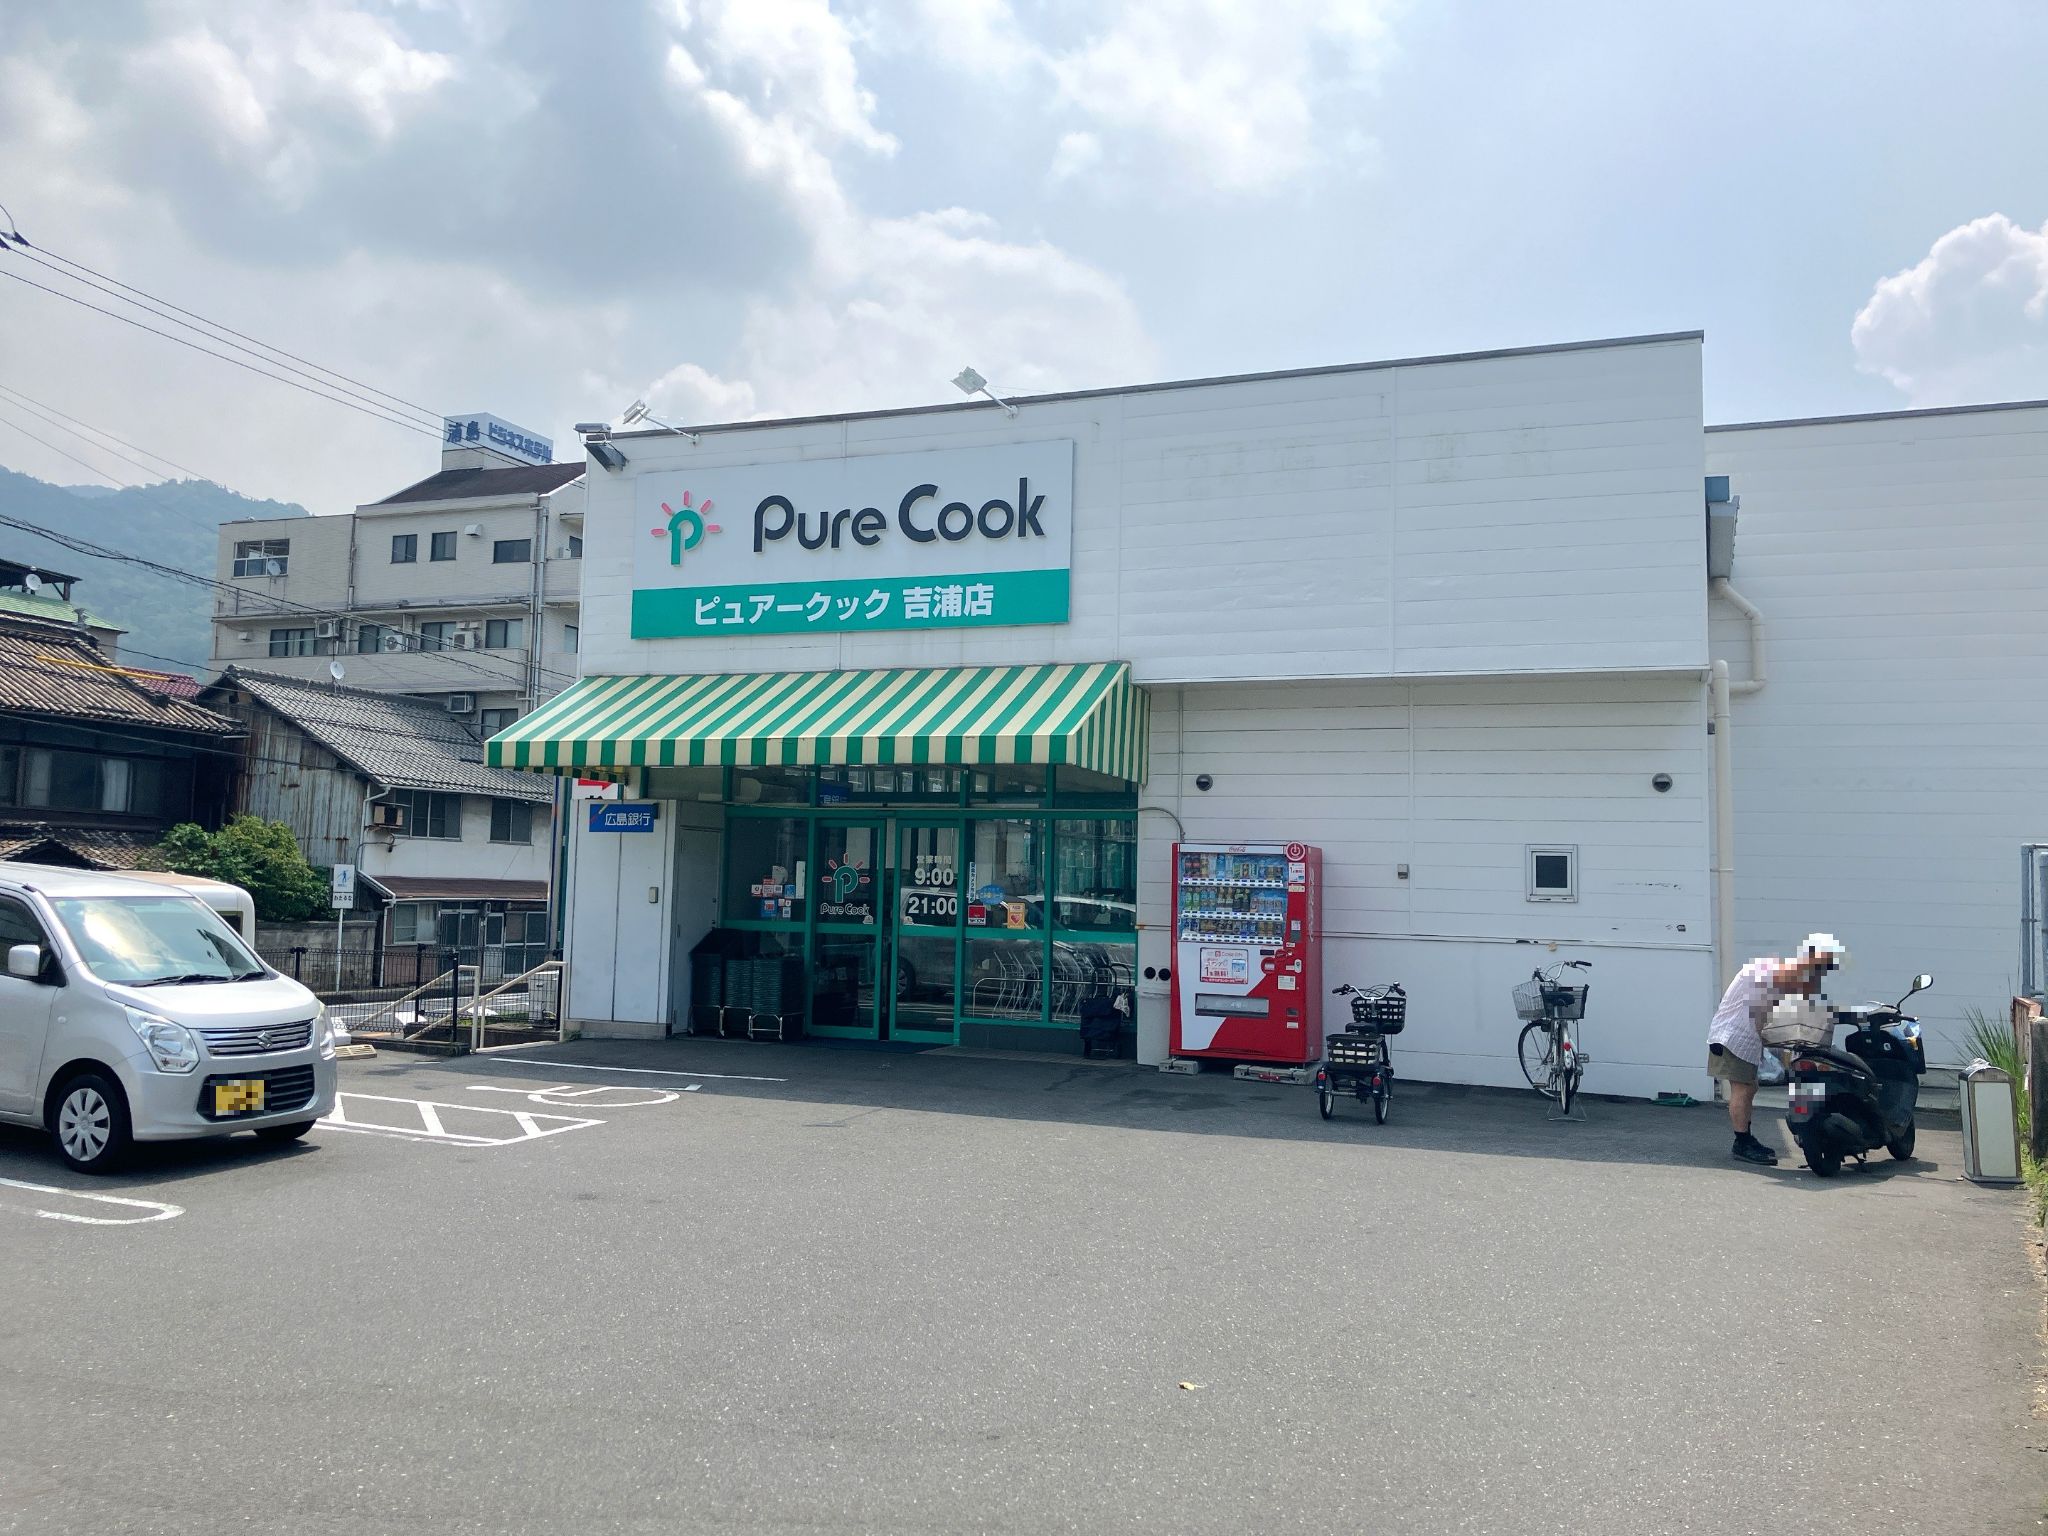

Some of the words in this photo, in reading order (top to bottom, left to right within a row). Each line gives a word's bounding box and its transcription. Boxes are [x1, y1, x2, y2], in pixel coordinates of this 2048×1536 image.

[753, 494, 887, 554] Pure
[898, 477, 1047, 544] Cook
[694, 589, 892, 626] ピュアークック
[902, 583, 994, 620] 吉浦店
[604, 812, 651, 827] 広島銀行
[914, 867, 954, 886] 9:00
[820, 902, 845, 915] Pure
[907, 896, 958, 916] 21:00
